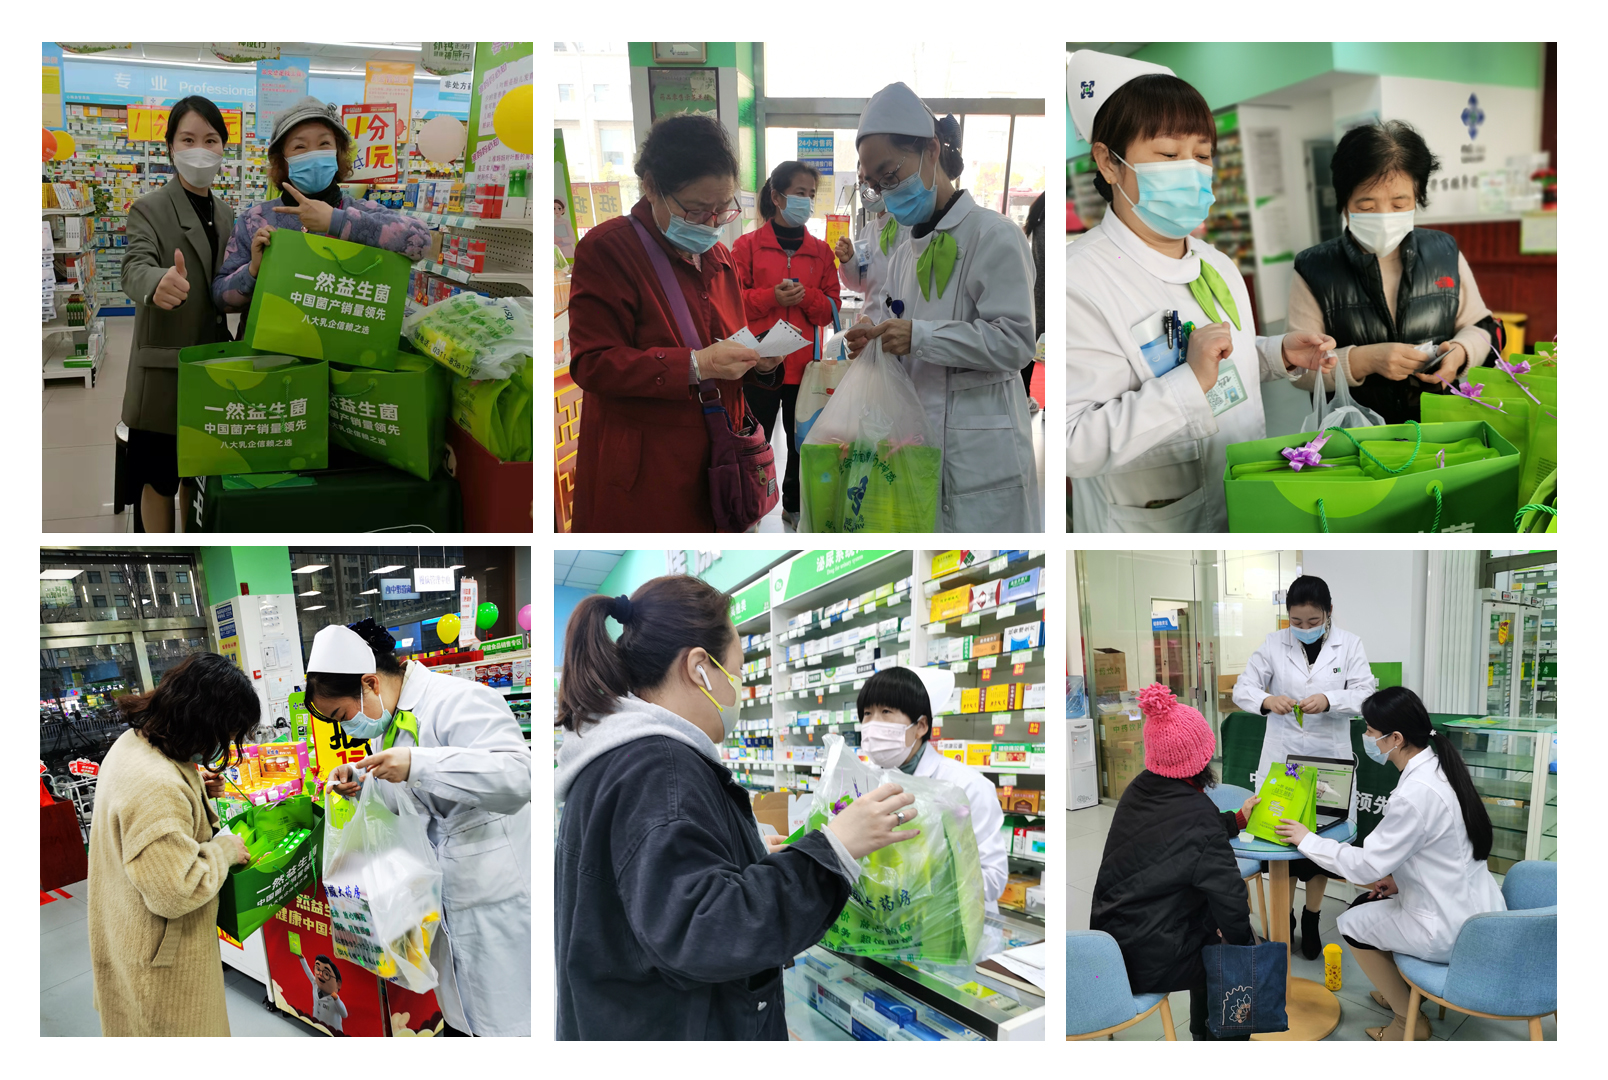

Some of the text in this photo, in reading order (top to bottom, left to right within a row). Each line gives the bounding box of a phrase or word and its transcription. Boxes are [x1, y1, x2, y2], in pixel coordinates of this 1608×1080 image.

[354, 113, 390, 141] 1分
[294, 270, 390, 305] 一然益生菌
[288, 291, 387, 321] 中国菌产销量领先
[301, 314, 370, 335] 八大乳企信赖之选
[204, 397, 309, 421] 一然益生菌
[204, 420, 307, 435] 中国菌产销量领先
[220, 438, 297, 449] 八大乳企信赖之选
